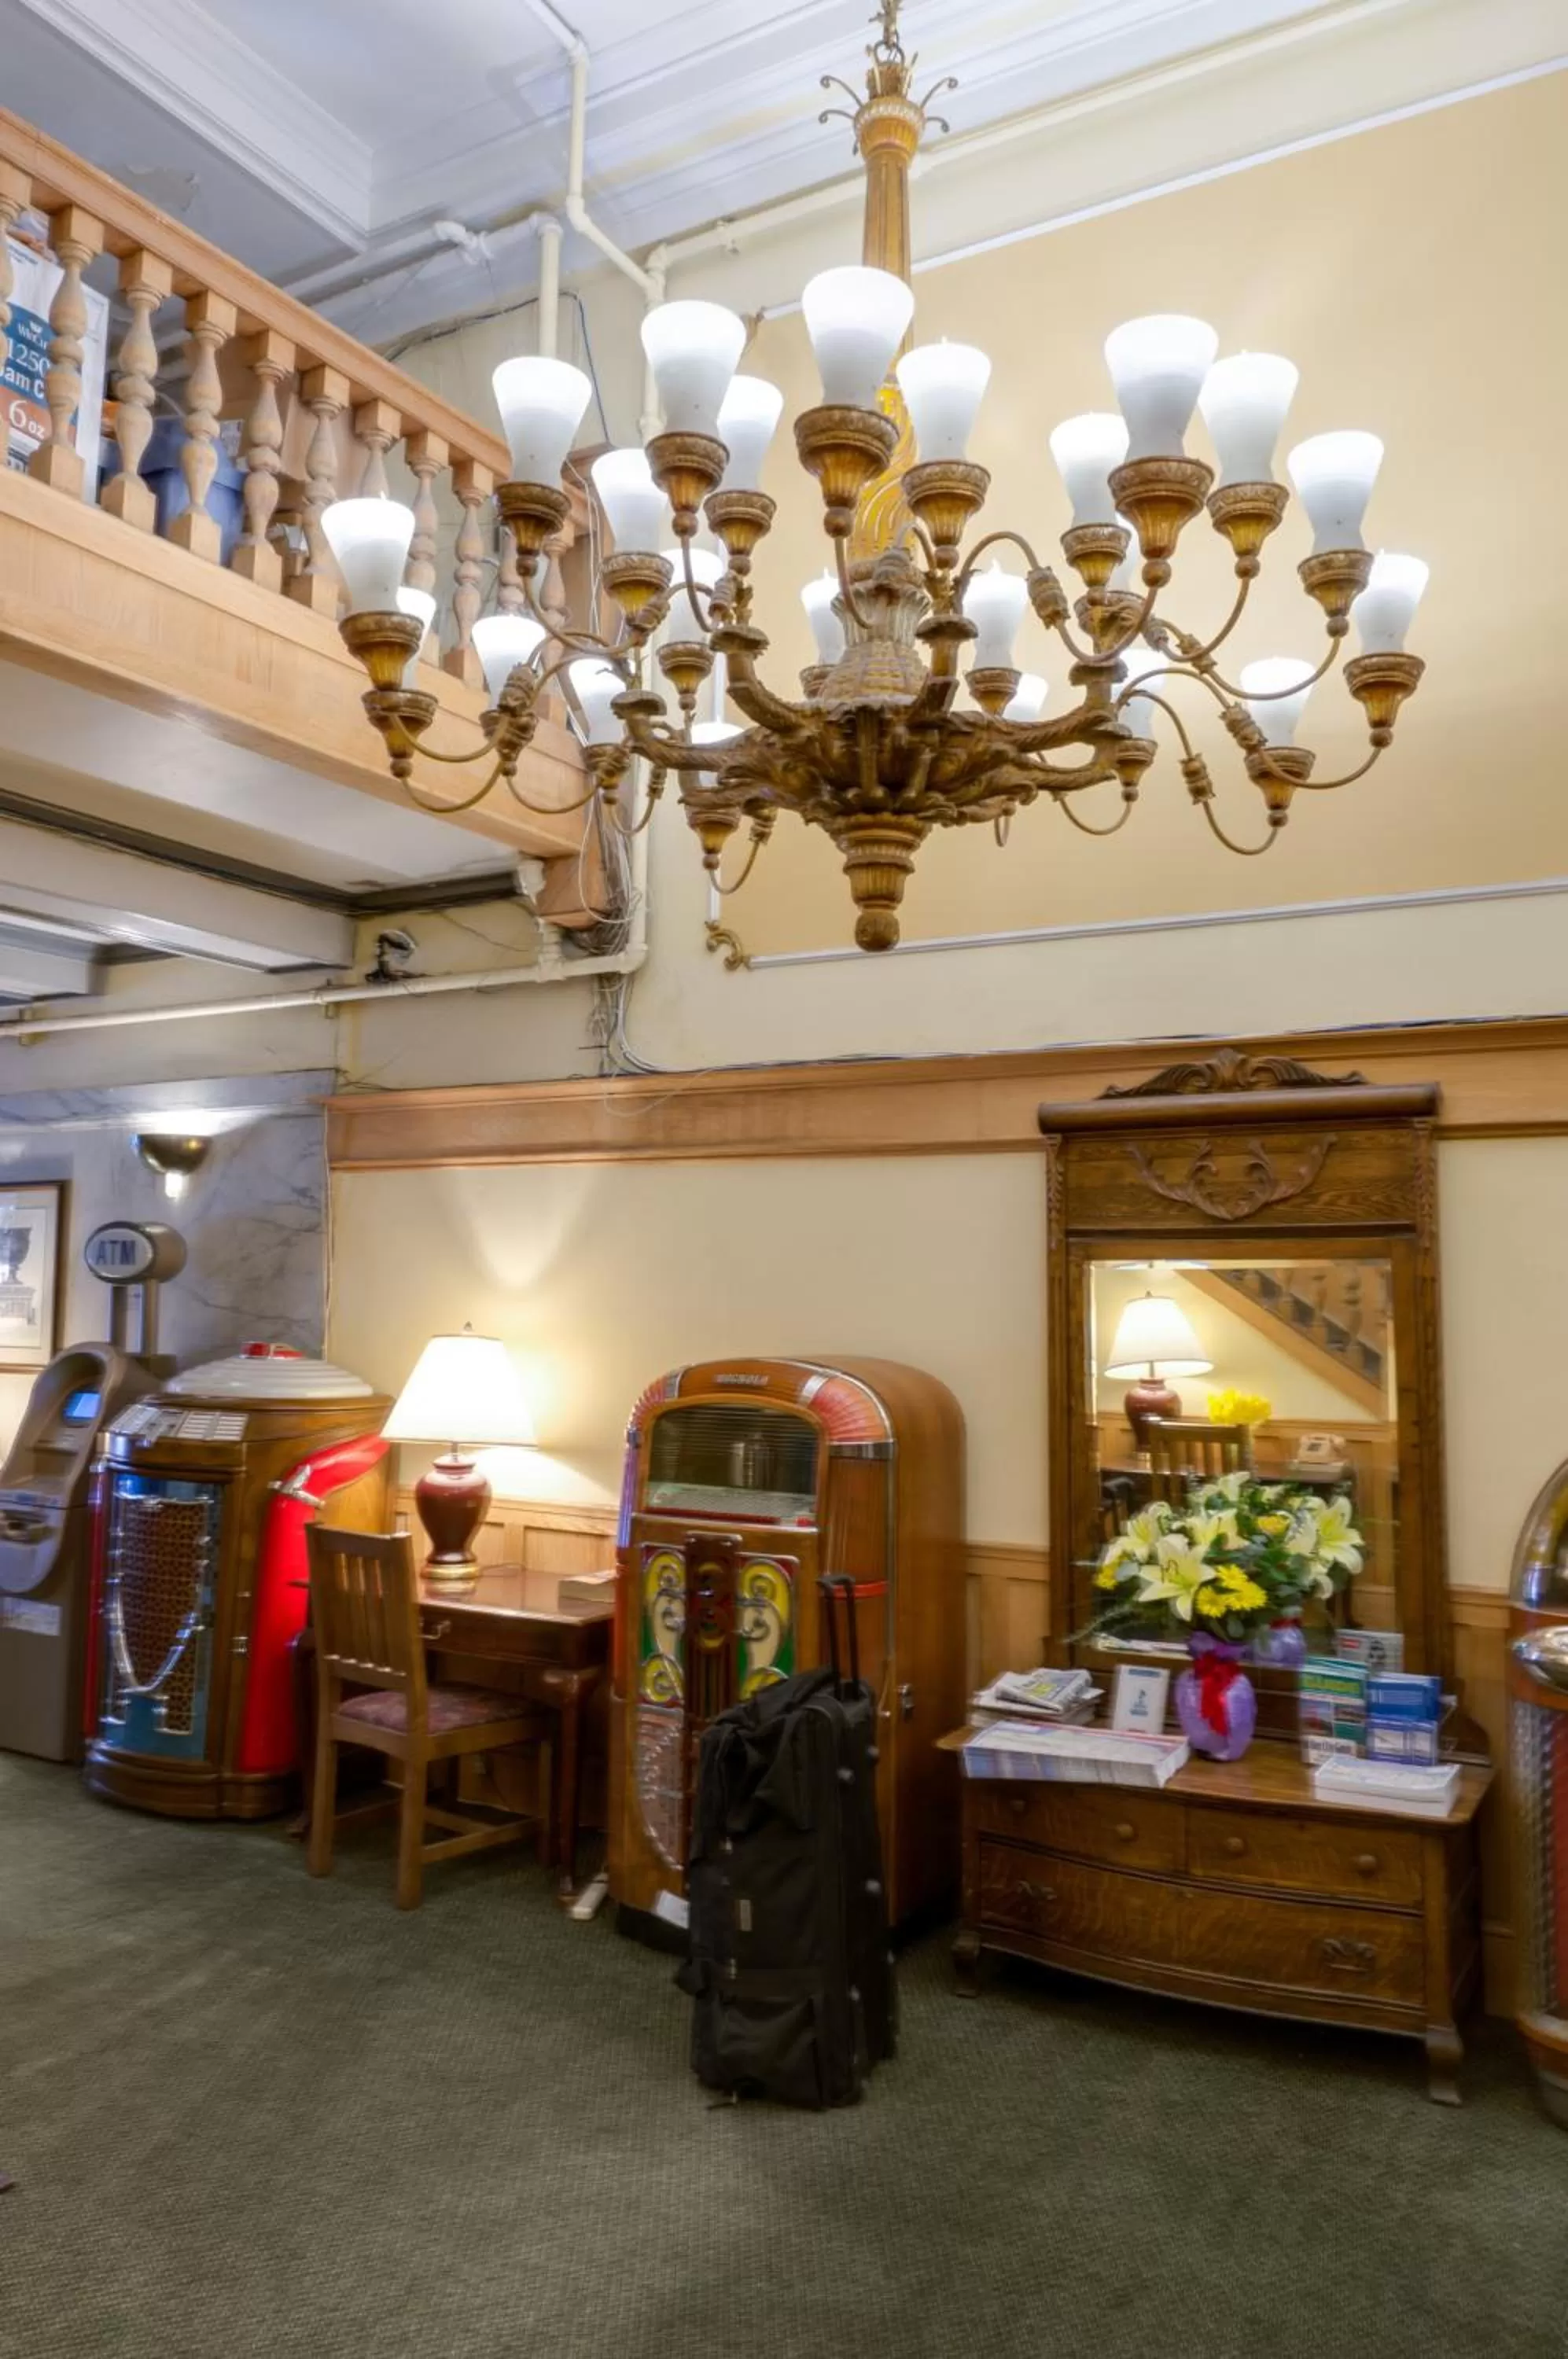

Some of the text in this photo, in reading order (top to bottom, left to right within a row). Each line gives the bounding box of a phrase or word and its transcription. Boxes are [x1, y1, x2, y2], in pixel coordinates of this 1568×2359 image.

[9, 400, 45, 440] 6 oz
[95, 1240, 136, 1265] ATM
